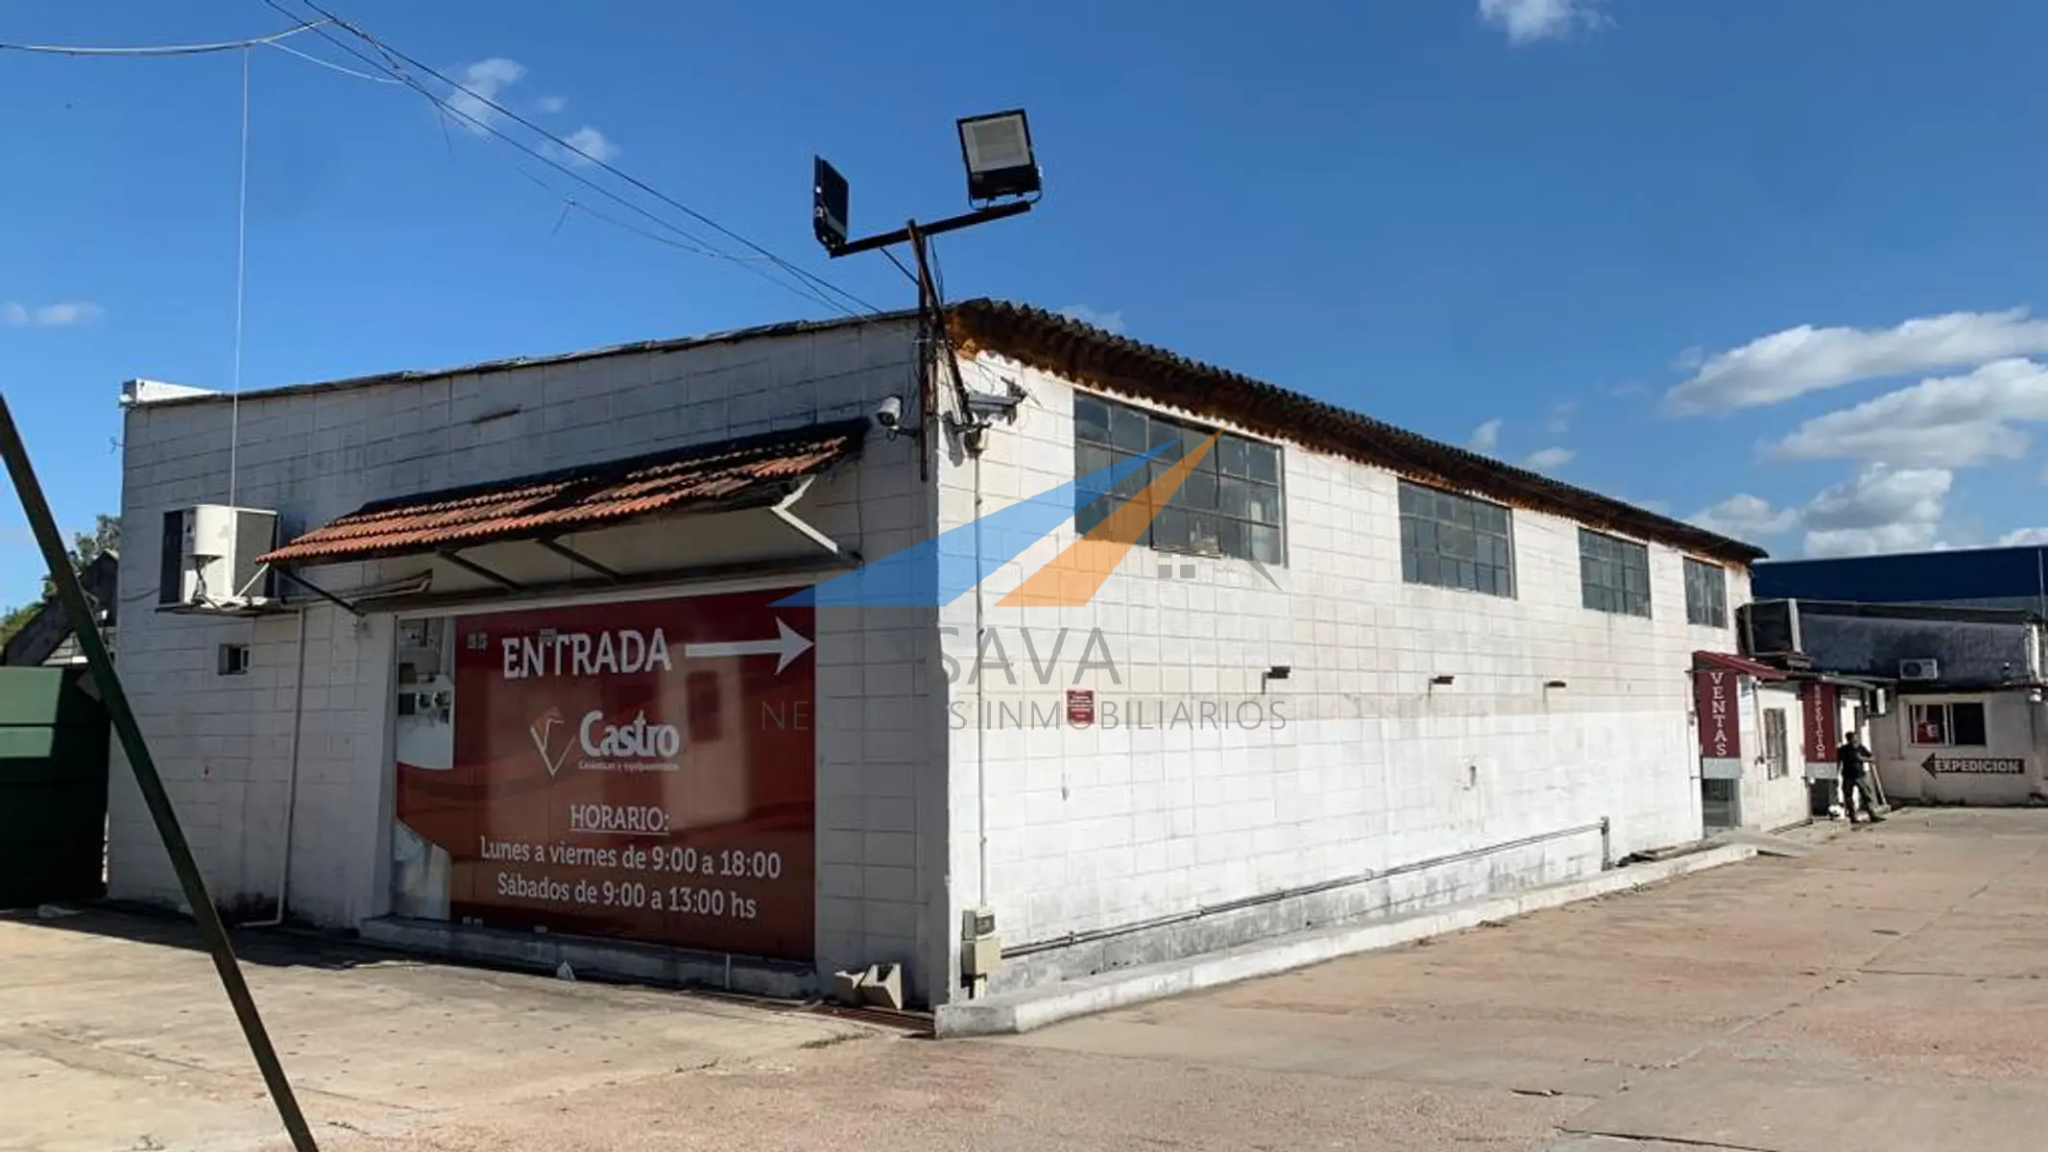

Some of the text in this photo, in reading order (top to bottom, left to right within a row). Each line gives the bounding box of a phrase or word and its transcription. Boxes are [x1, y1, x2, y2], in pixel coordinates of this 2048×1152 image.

[502, 628, 672, 679] ENTRADA
[580, 710, 680, 757] Castro
[1709, 672, 1727, 757] VENTAS
[1934, 760, 2020, 772] EXPEDICION
[570, 804, 670, 834] HORARIO:
[480, 835, 781, 879] Lunes a viernes de 9:00 a 18:00
[497, 872, 756, 919] Sábados de 9:00 a 13:00 hs
